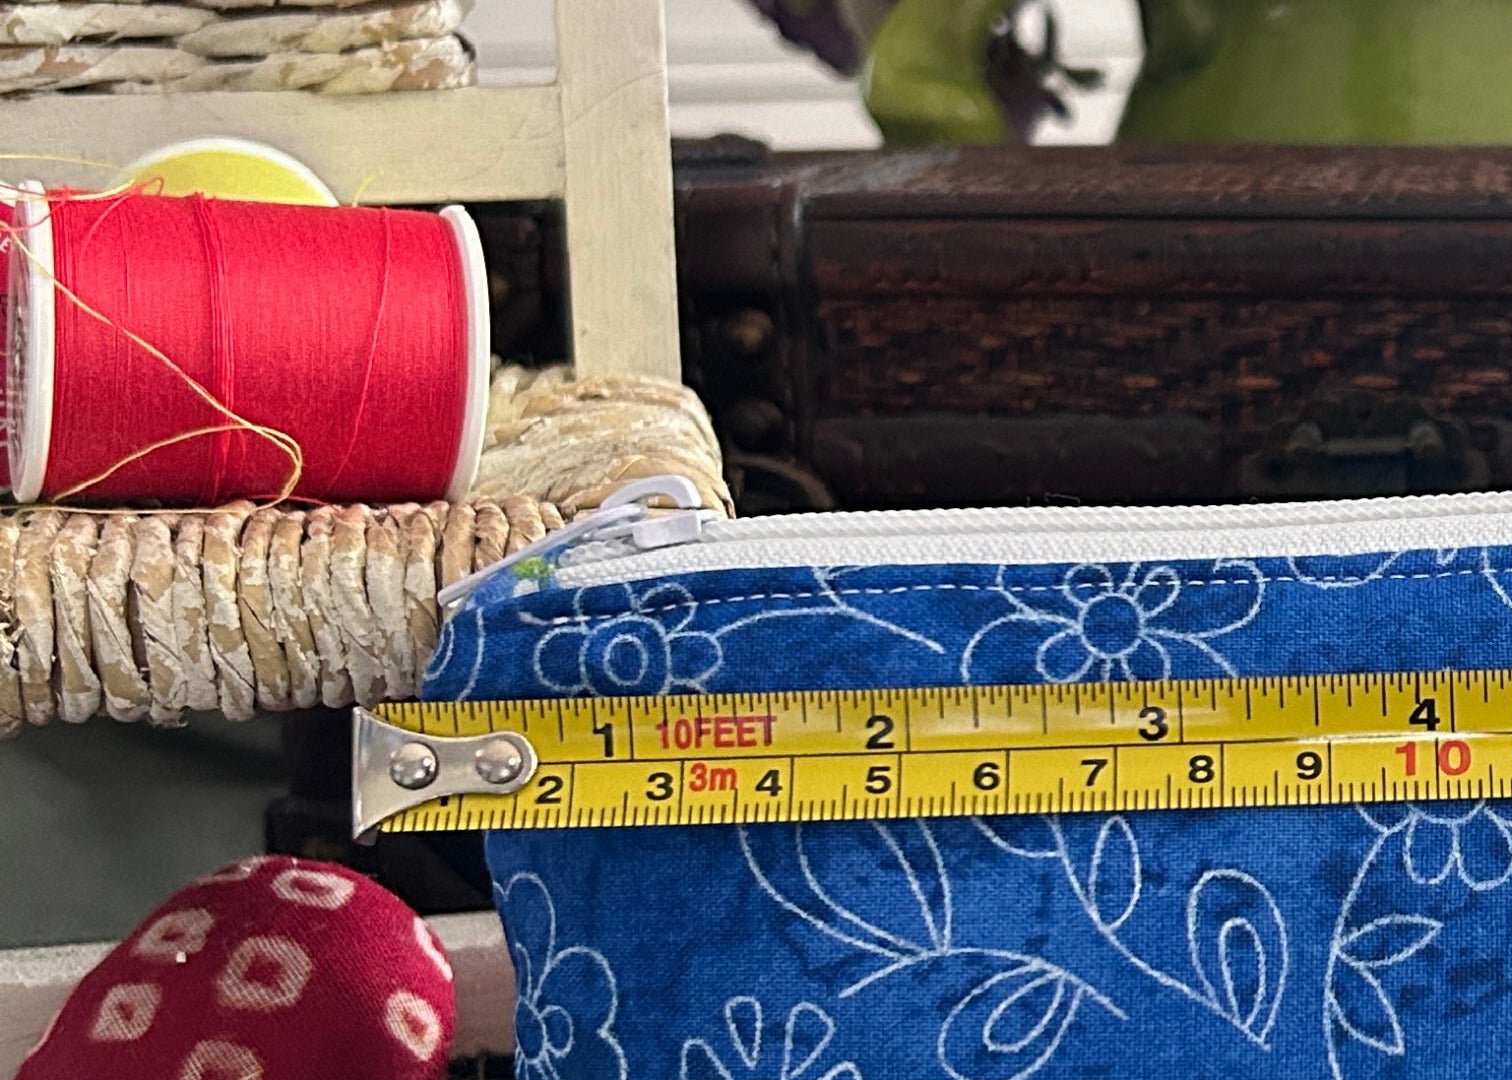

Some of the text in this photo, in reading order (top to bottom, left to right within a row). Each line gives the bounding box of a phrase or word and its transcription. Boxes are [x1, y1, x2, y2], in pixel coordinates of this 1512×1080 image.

[593, 723, 614, 758] 1
[655, 715, 778, 751] 10FEET
[864, 715, 895, 750] 2
[1138, 706, 1168, 741] 3
[1408, 698, 1441, 732] 4
[537, 775, 563, 804] 2
[646, 772, 674, 800] 3
[688, 763, 738, 792] 3m
[755, 769, 782, 797] 4
[864, 766, 892, 795] 5
[973, 762, 1001, 791] 6
[1080, 758, 1108, 787] 7
[1188, 755, 1215, 784] 8
[1295, 752, 1322, 780] 9
